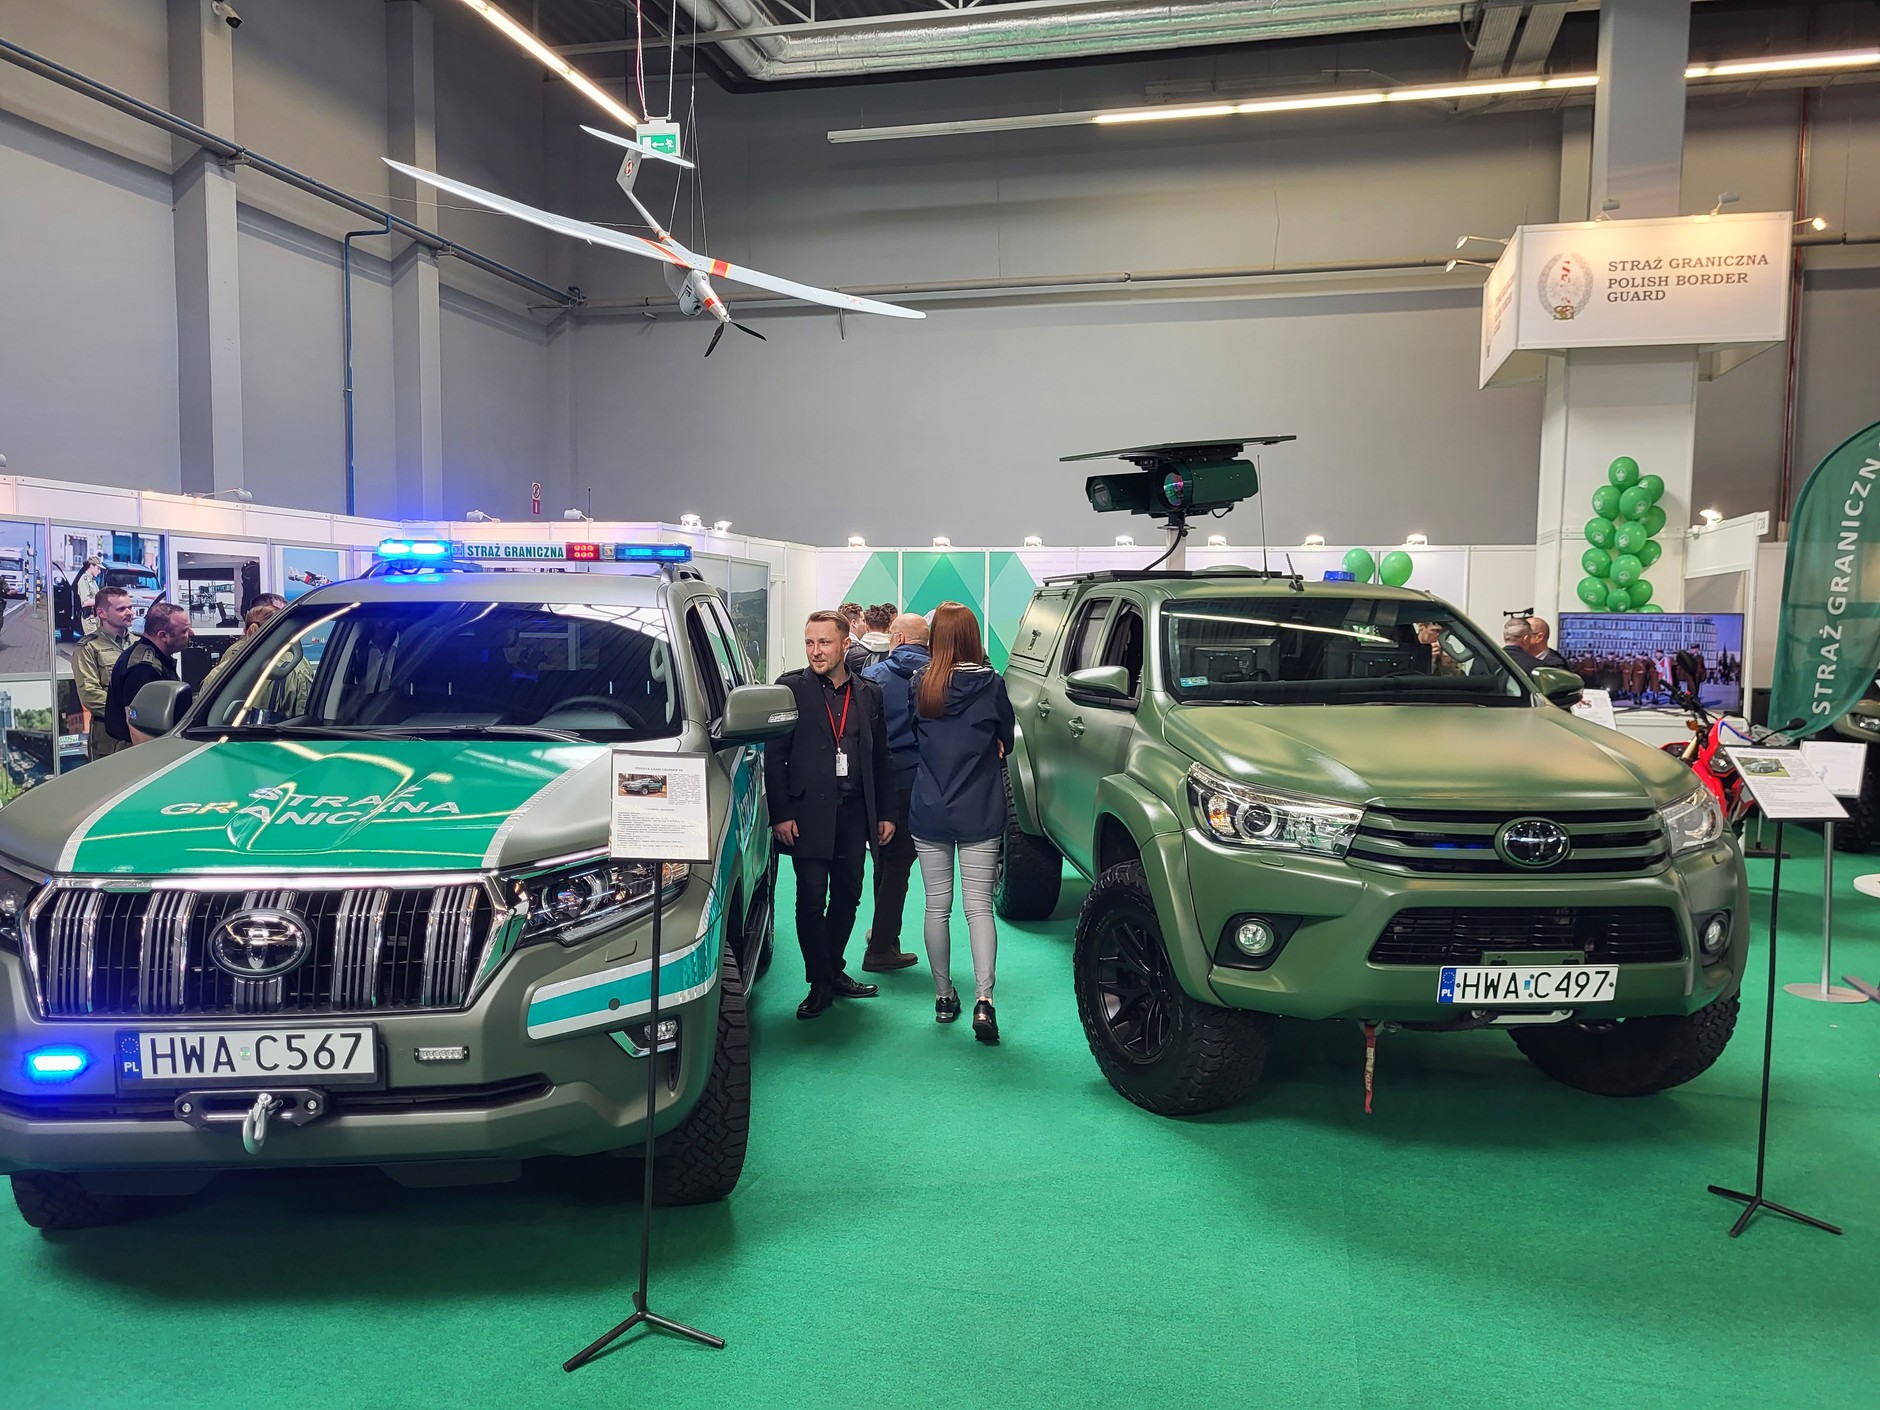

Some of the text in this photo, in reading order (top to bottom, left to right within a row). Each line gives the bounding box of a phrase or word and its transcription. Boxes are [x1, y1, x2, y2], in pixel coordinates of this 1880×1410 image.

[1608, 254, 1769, 272] STRAŻ GRANICZNA
[1608, 272, 1749, 289] POLISH BORDER
[1607, 289, 1666, 303] GUARD
[1827, 441, 1880, 616] GRANICZN
[467, 543, 564, 558] STRAŻ GRANICZNA
[1812, 625, 1843, 716] STRAŻ
[1441, 971, 1610, 999] PL HWA C497
[124, 1033, 362, 1075] PL HWA C567
